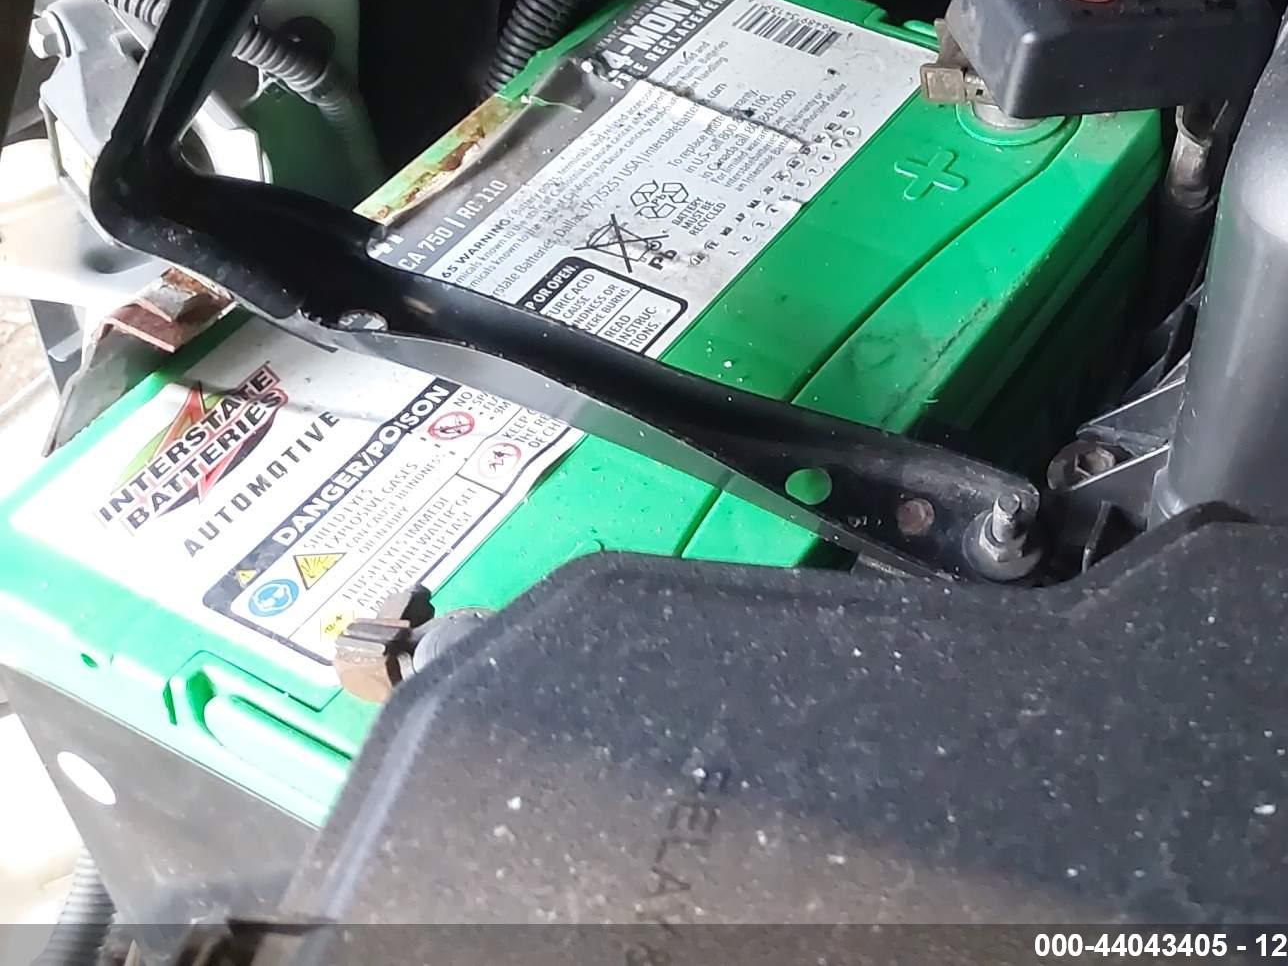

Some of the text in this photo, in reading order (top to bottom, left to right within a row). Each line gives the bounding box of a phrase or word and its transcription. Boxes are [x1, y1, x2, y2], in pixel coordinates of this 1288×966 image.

[677, 134, 710, 159] replace
[706, 145, 738, 170] Canada
[513, 236, 560, 272] Batteries,
[552, 211, 587, 236] Dallas,
[590, 176, 624, 201] 75251
[618, 159, 642, 176] USA
[671, 197, 704, 224] BATTERY
[681, 210, 705, 228] MUST
[688, 202, 727, 235] RECYCLED
[396, 251, 428, 269] CA
[416, 226, 454, 251] 750
[455, 200, 484, 218] RC
[474, 179, 508, 201] 110
[440, 265, 459, 278] 65
[455, 215, 514, 263] WARNING:
[647, 248, 678, 269] Pb
[531, 288, 553, 302] OR
[545, 263, 579, 289] OPEN.
[573, 273, 595, 289] ACID
[562, 295, 590, 318] CAUSE
[600, 286, 632, 312] BURNS.
[604, 315, 631, 337] READ
[616, 306, 658, 342] INSTRUC-
[628, 320, 661, 346] TIONS.
[453, 391, 473, 408] NO
[503, 413, 528, 439] KEEP
[98, 368, 279, 523] INTERSTATE
[125, 388, 288, 530] BATTERIES
[273, 383, 449, 548] DANGER/POISON
[182, 409, 339, 558] AUTOMOTIVE
